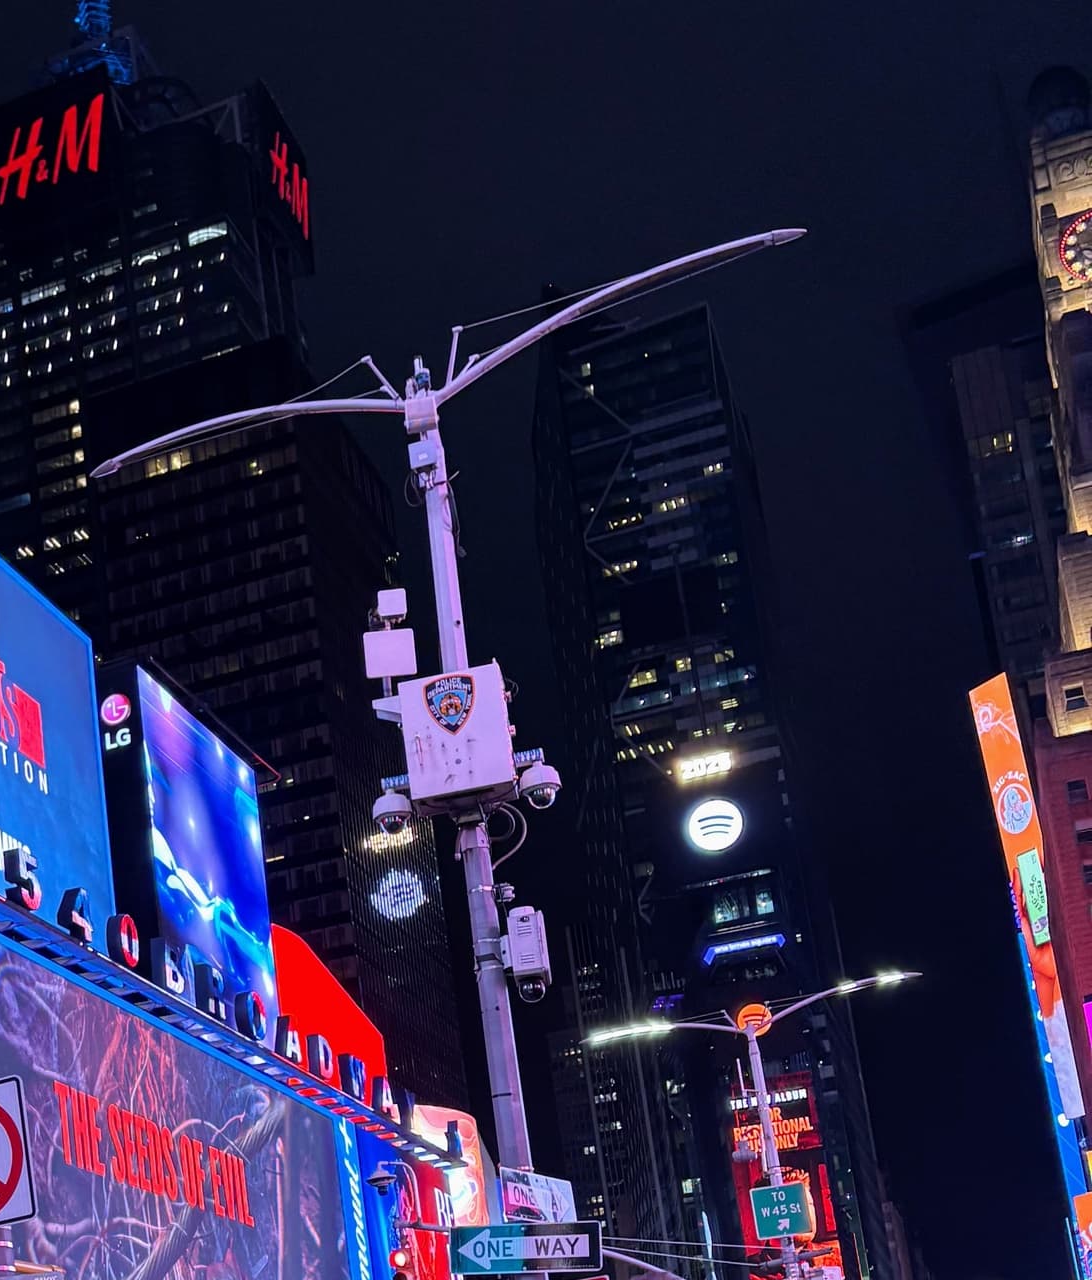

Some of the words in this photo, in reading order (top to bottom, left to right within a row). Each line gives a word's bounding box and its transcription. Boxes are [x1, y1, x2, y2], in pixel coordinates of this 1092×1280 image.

[269, 131, 309, 241] H&M
[105, 728, 131, 750] LG
[680, 752, 732, 781] 2025
[775, 1088, 807, 1103] ALBUM
[769, 1107, 783, 1120] OR
[53, 1080, 105, 1177] THE
[108, 1103, 178, 1201] SEEDS
[180, 1134, 205, 1211] OF
[208, 1146, 255, 1228] EVIL
[513, 1186, 535, 1206] ONE
[772, 1191, 785, 1201] TO
[761, 1207, 772, 1217] W
[773, 1205, 787, 1215] 45
[790, 1203, 802, 1213] St
[473, 1240, 514, 1258] ONE
[535, 1237, 580, 1256] WAY
